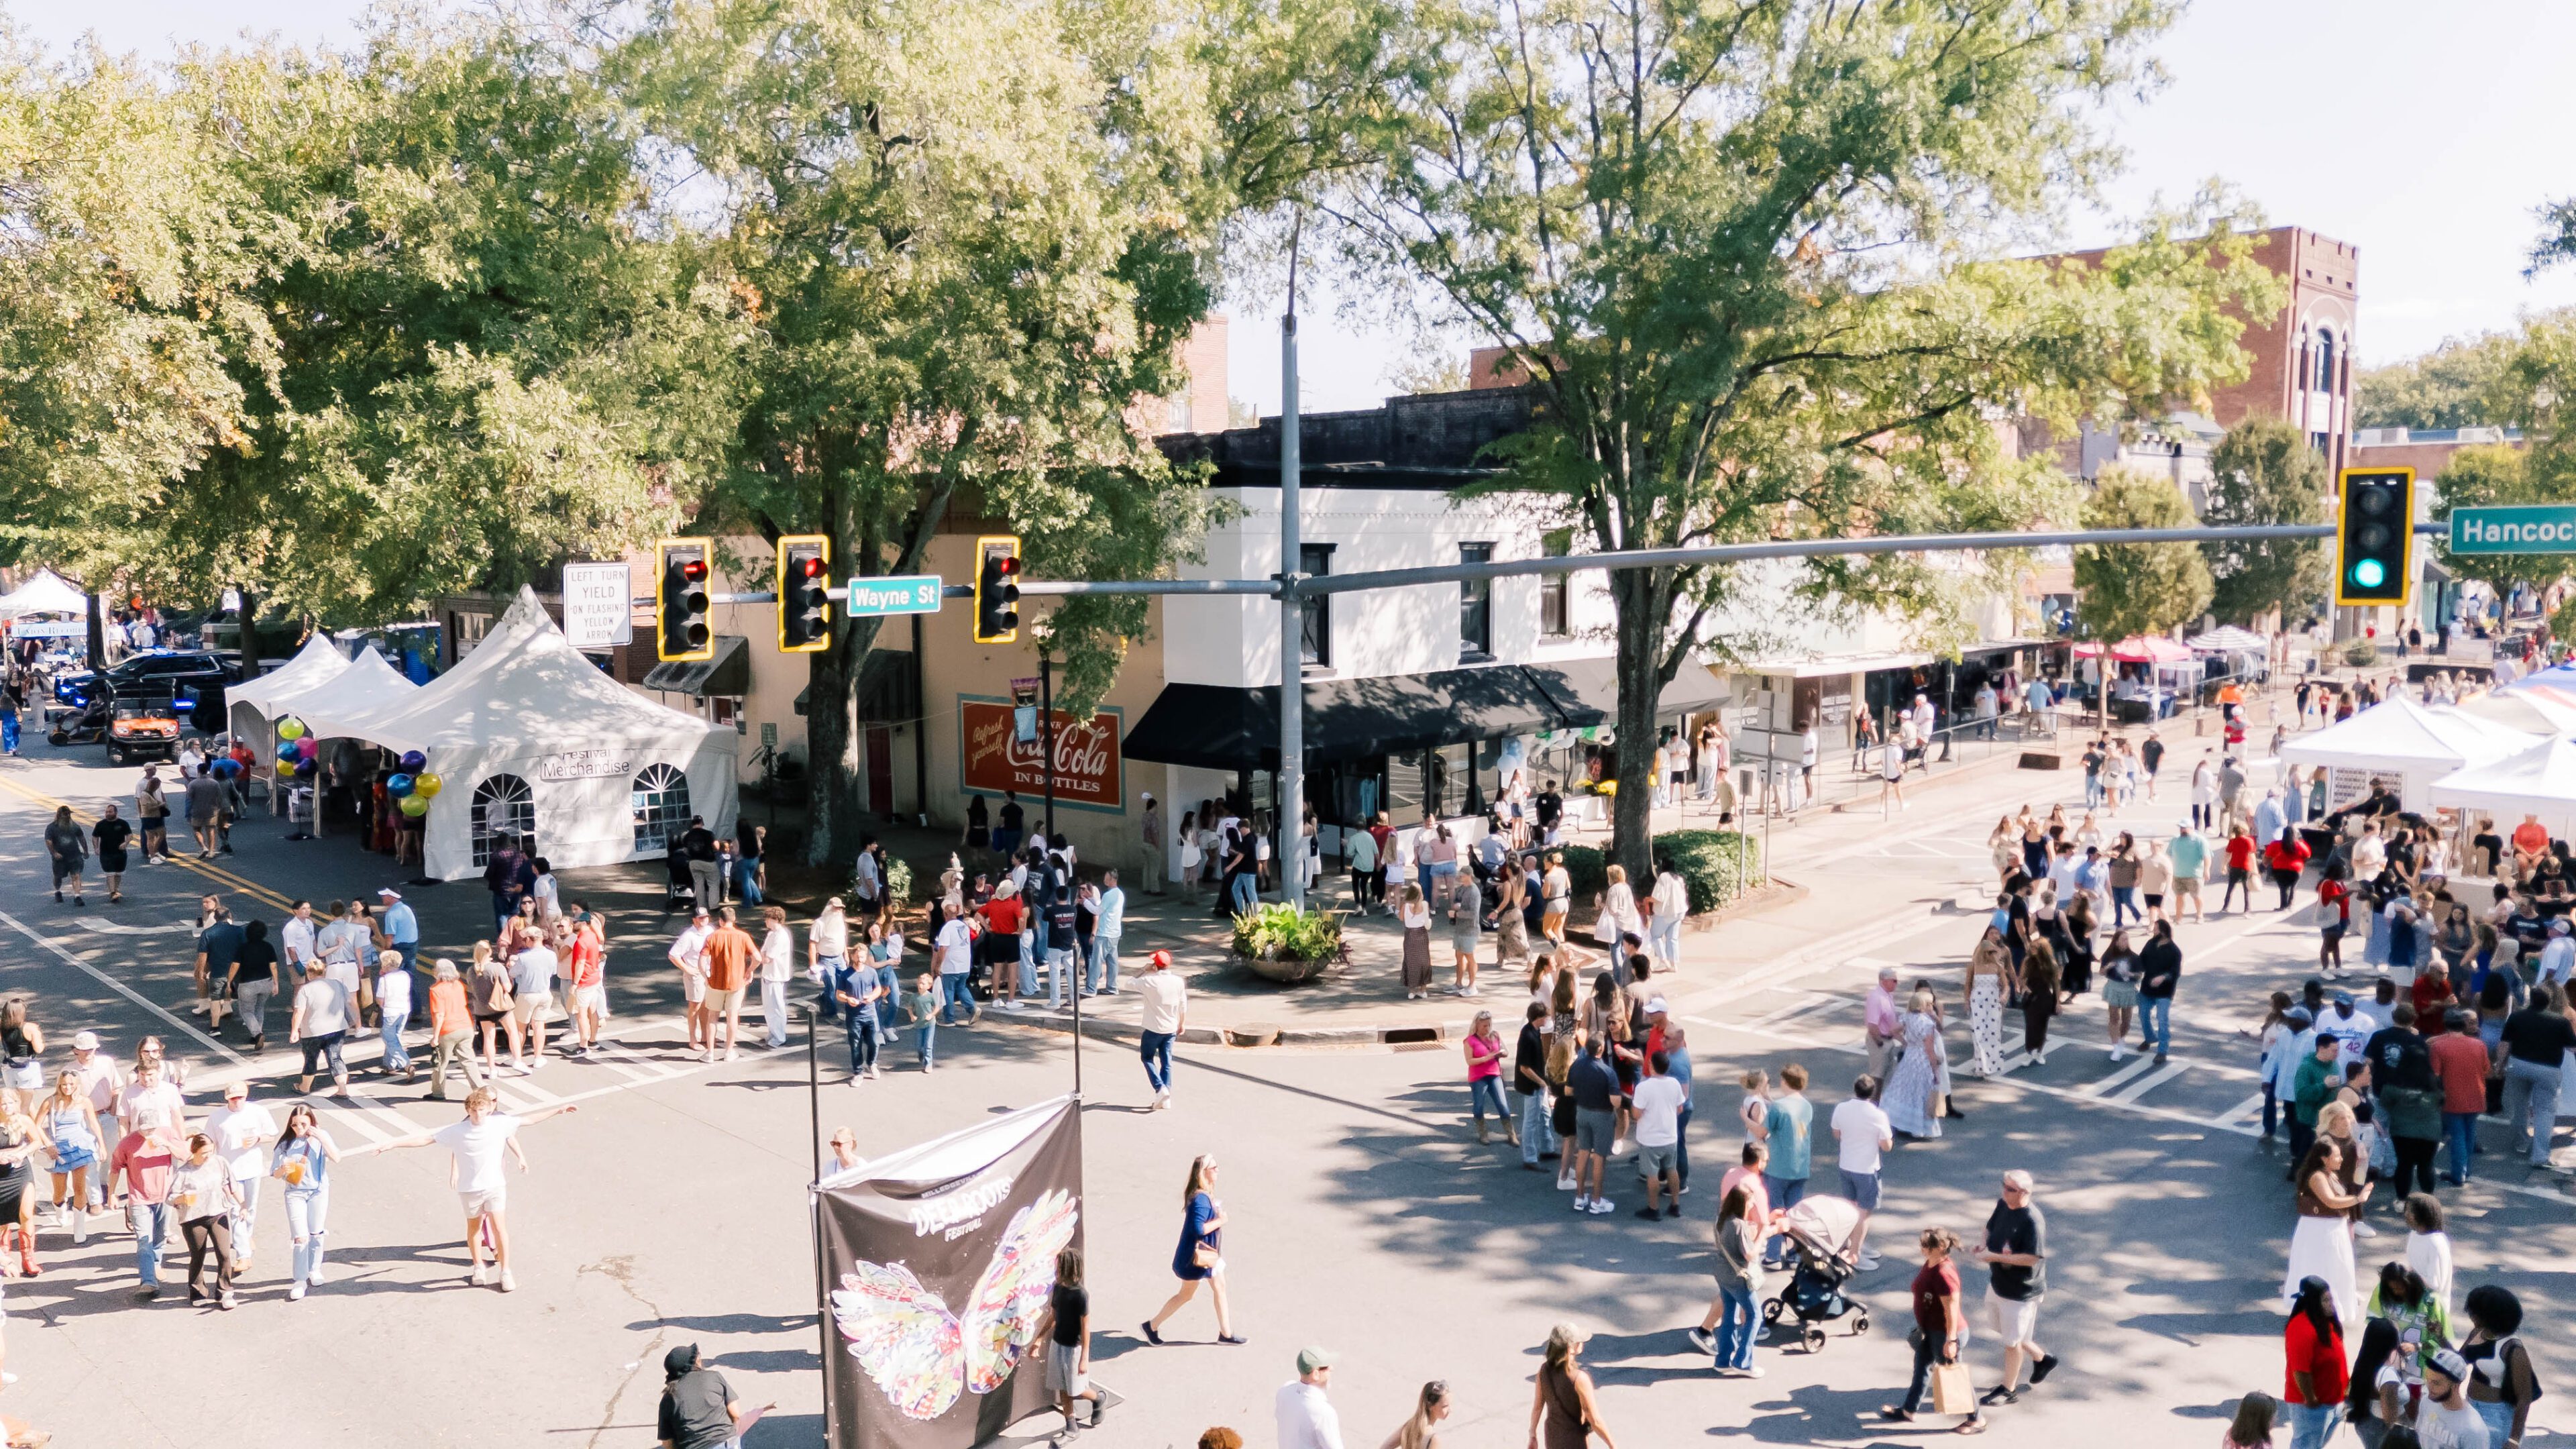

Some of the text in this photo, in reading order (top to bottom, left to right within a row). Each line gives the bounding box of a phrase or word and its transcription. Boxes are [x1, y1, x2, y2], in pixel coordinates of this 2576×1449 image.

[2463, 519, 2576, 542] Hancoc
[571, 570, 625, 582] LEFT TURN
[582, 586, 615, 599] YIELD
[855, 585, 935, 610] Wayne St
[573, 603, 625, 615] ON FLASHING
[584, 616, 614, 628] YELLOW
[586, 629, 613, 640] ARROW
[973, 715, 1004, 745] Refresh
[1038, 720, 1063, 730] RNK
[971, 733, 1005, 771] yourself
[543, 760, 630, 777] Merchandise
[1014, 771, 1031, 784] IN
[2345, 1041, 2361, 1053] 42
[910, 1177, 1014, 1237] DEEP ROOTS
[945, 1218, 983, 1242] FESTIVAL
